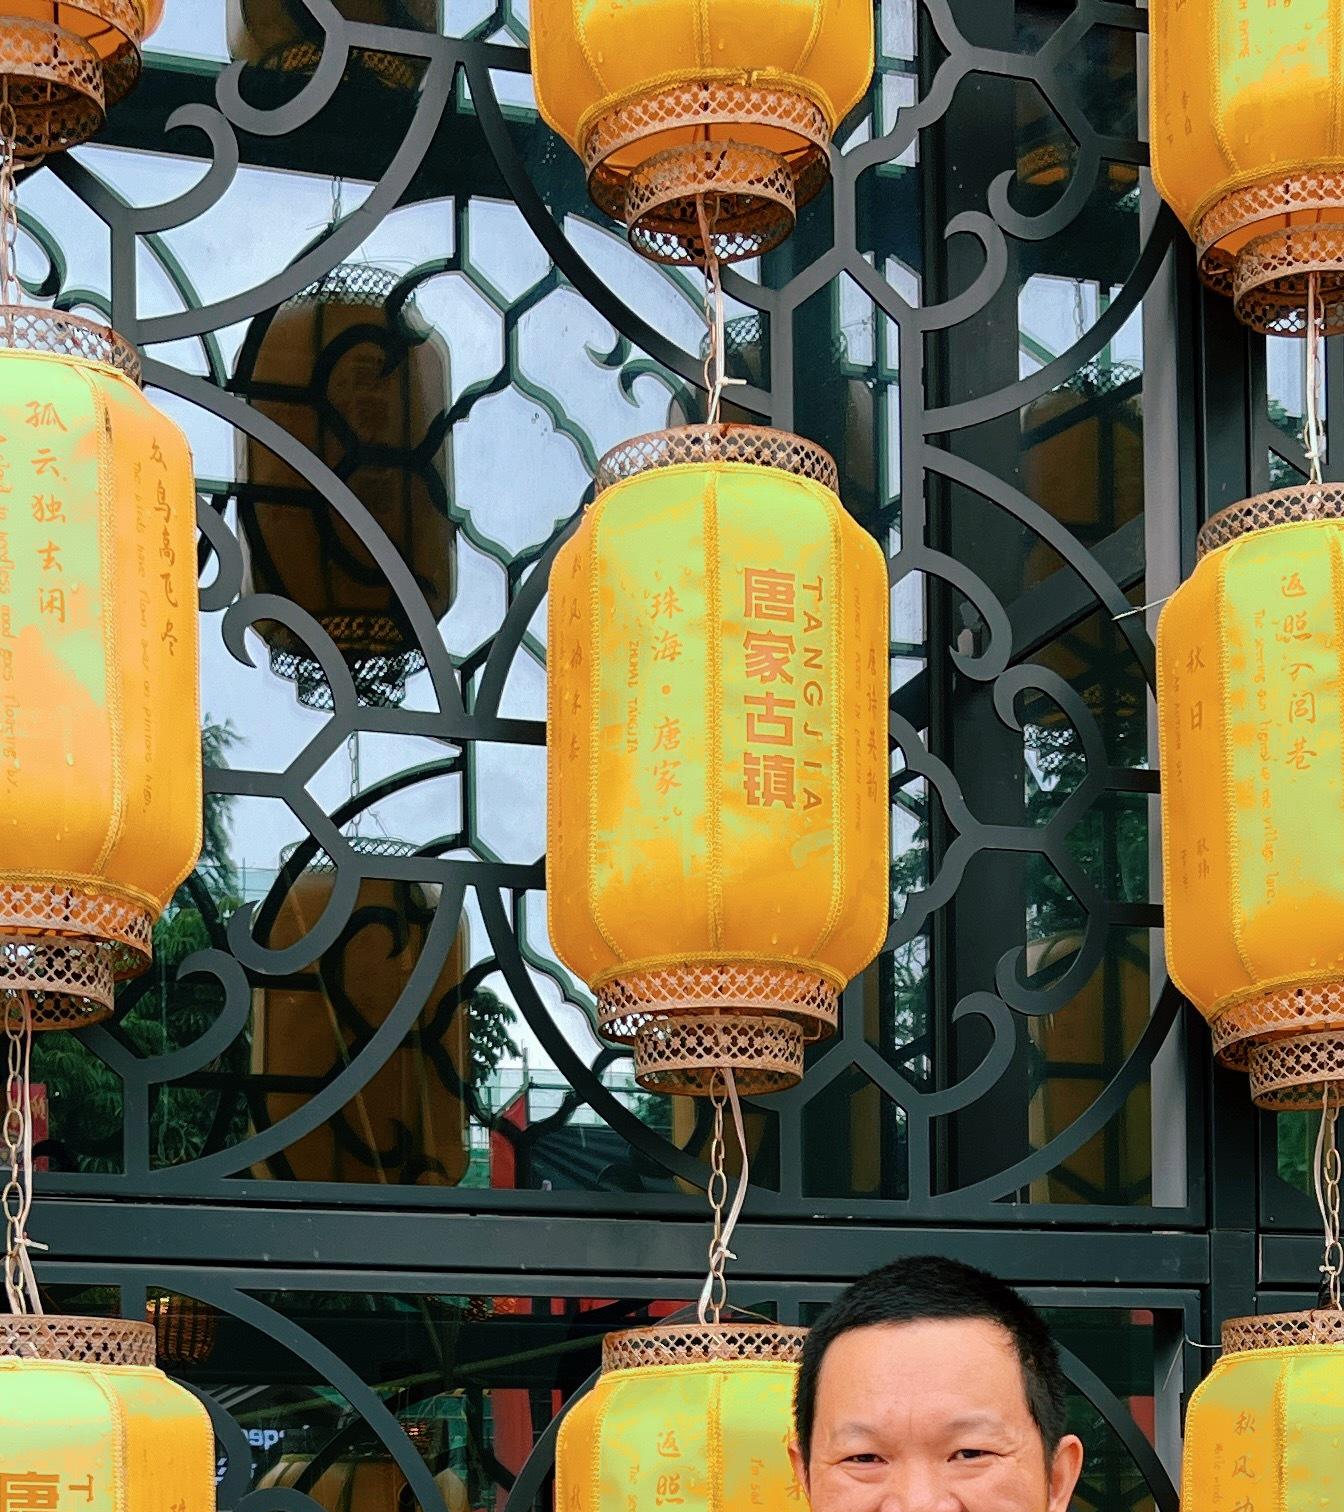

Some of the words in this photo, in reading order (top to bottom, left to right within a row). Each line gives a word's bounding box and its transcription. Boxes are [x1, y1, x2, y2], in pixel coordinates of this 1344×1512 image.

[26, 401, 67, 624] 孤云独去闲
[627, 697, 638, 753] TANGJIA
[628, 641, 639, 688] ZHUHAI
[743, 568, 796, 809] 唐家古镇
[802, 577, 823, 811] TANGJIA
[1186, 645, 1205, 732] 秋日
[1279, 572, 1317, 771] 返照入闾巷
